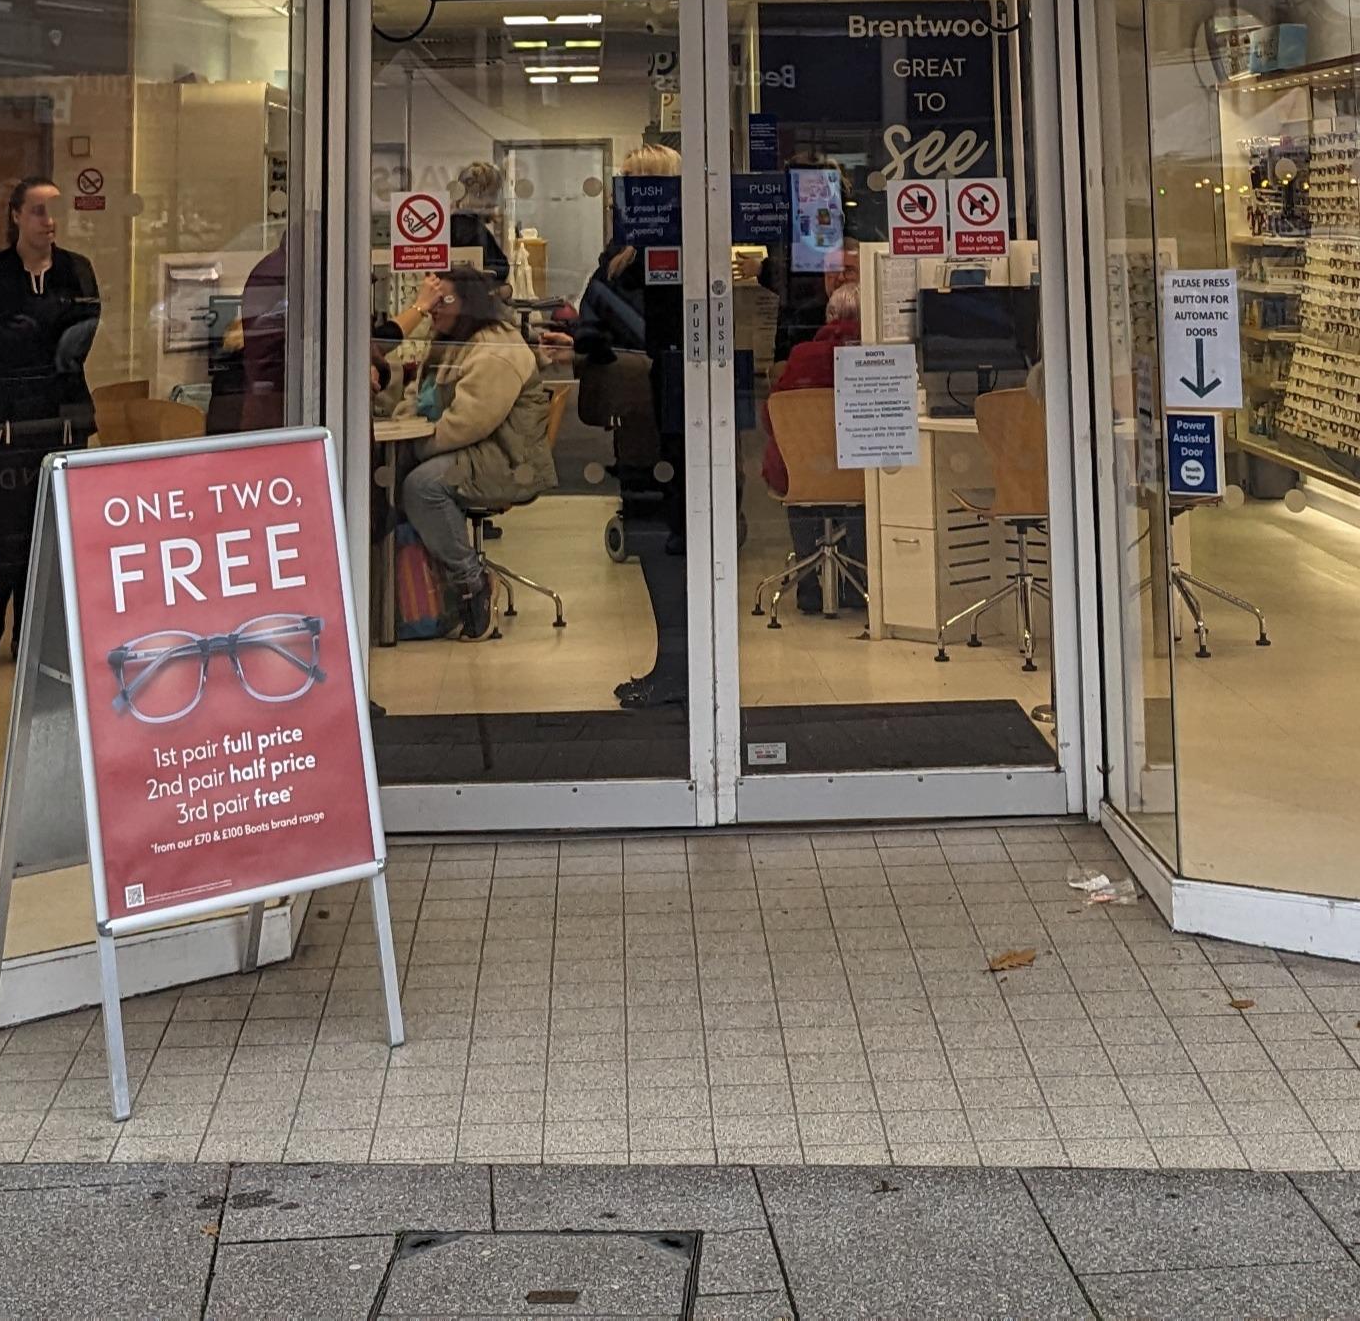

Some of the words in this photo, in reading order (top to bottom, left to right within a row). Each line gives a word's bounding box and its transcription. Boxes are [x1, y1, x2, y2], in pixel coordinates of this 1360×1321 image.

[893, 58, 966, 78] GREAT
[914, 93, 946, 112] TO
[882, 124, 989, 179] See
[631, 186, 663, 197] PUSH
[749, 184, 782, 195] PUSH
[962, 235, 975, 244] No
[976, 235, 999, 246] dogs
[1172, 278, 1201, 289] PLEASE
[1203, 278, 1230, 288] PRESS
[1173, 294, 1209, 305] BUTTON
[1211, 294, 1230, 304] FOR
[1174, 310, 1229, 321] AUTOMATIC
[1185, 327, 1219, 338] DOORS
[1176, 420, 1206, 430] Power
[1173, 432, 1211, 444] Assisted
[1181, 446, 1204, 456] Door
[104, 490, 195, 527] ONE,
[208, 477, 303, 514] TWO,
[110, 522, 307, 614] FREE
[153, 747, 178, 768] 1st
[182, 740, 219, 769] pair
[223, 731, 253, 755] full
[257, 725, 303, 755] price
[146, 774, 183, 801] 2nd
[188, 768, 226, 798] pair
[230, 758, 267, 784] half
[270, 752, 316, 782] price
[176, 799, 208, 824] 3rd
[213, 793, 249, 823] pair
[177, 838, 194, 850] our
[194, 832, 212, 847] £70
[213, 830, 222, 843] &
[222, 826, 244, 841] £100
[244, 821, 270, 836] Boots
[271, 815, 298, 830] brand
[298, 811, 325, 825] range
